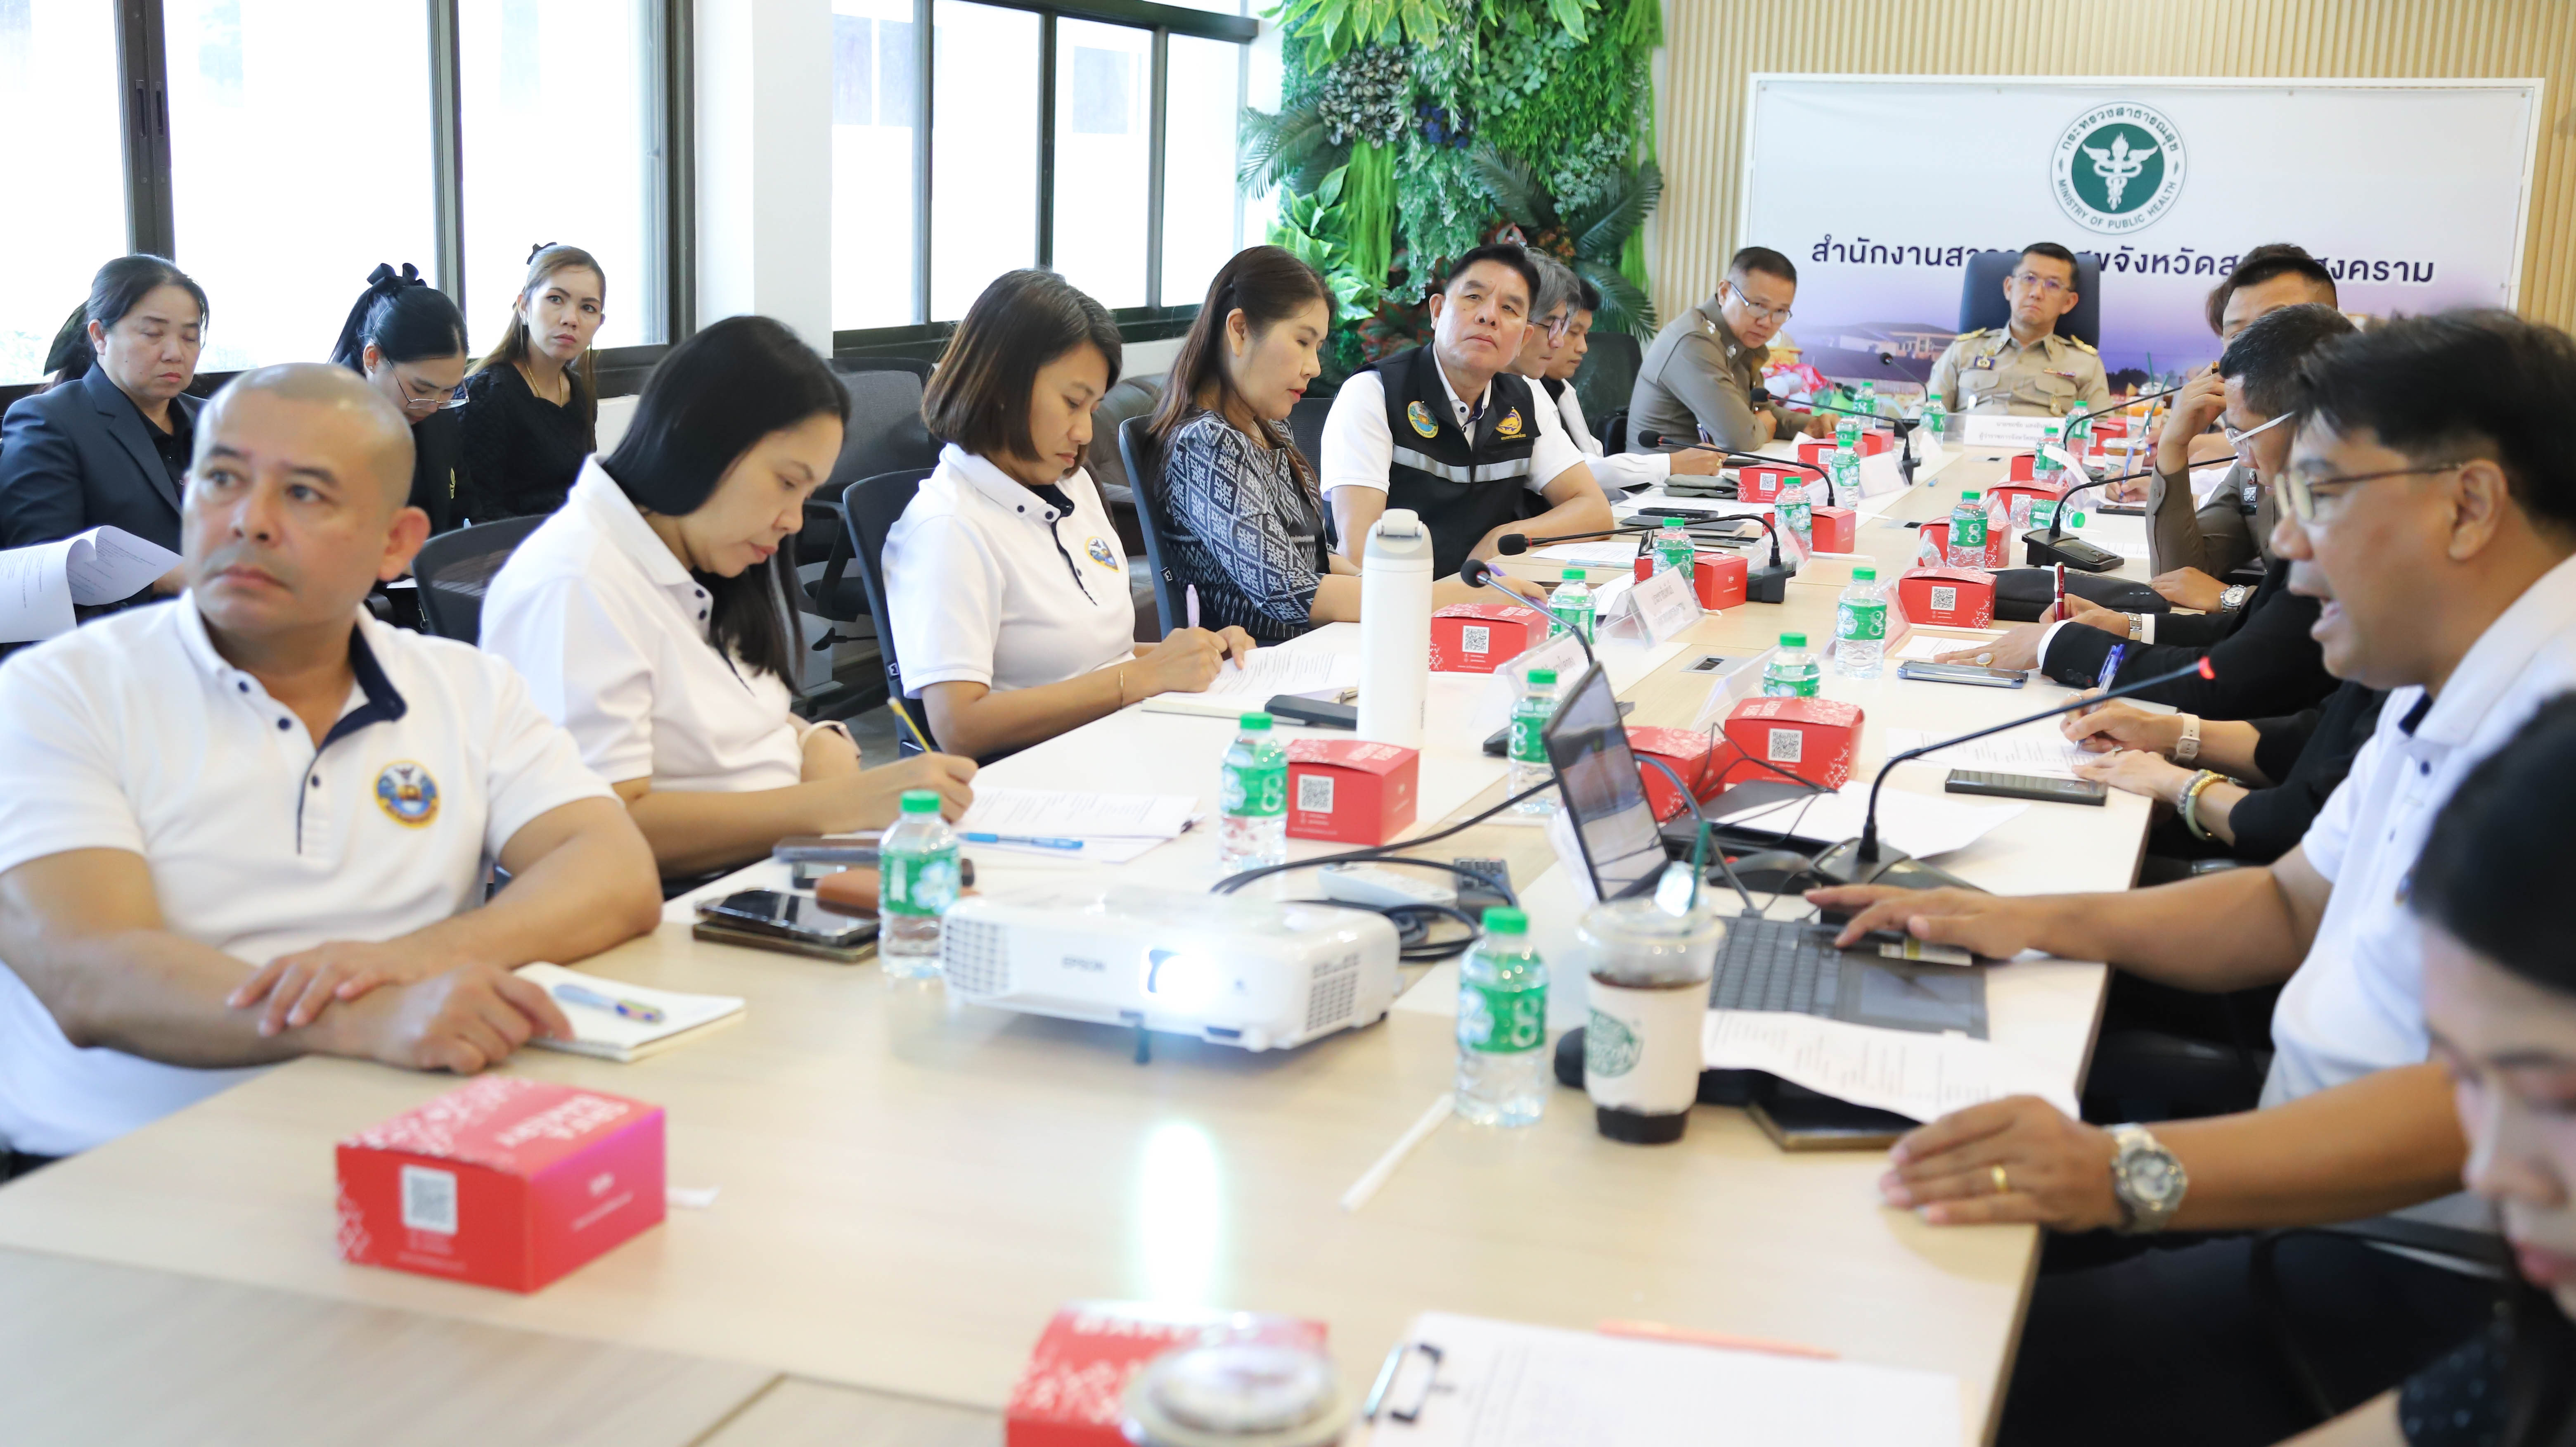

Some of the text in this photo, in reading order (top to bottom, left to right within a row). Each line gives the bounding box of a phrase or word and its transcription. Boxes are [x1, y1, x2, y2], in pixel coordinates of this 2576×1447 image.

[2061, 107, 2180, 152] กระทรวงสาธารณสุข
[2058, 178, 2177, 229] MINISTRY OF PUBLIC HEALTH
[1967, 523, 1981, 543] 8
[1869, 610, 1884, 636] 8
[1261, 773, 1283, 812] 8
[1511, 995, 1540, 1048] 8
